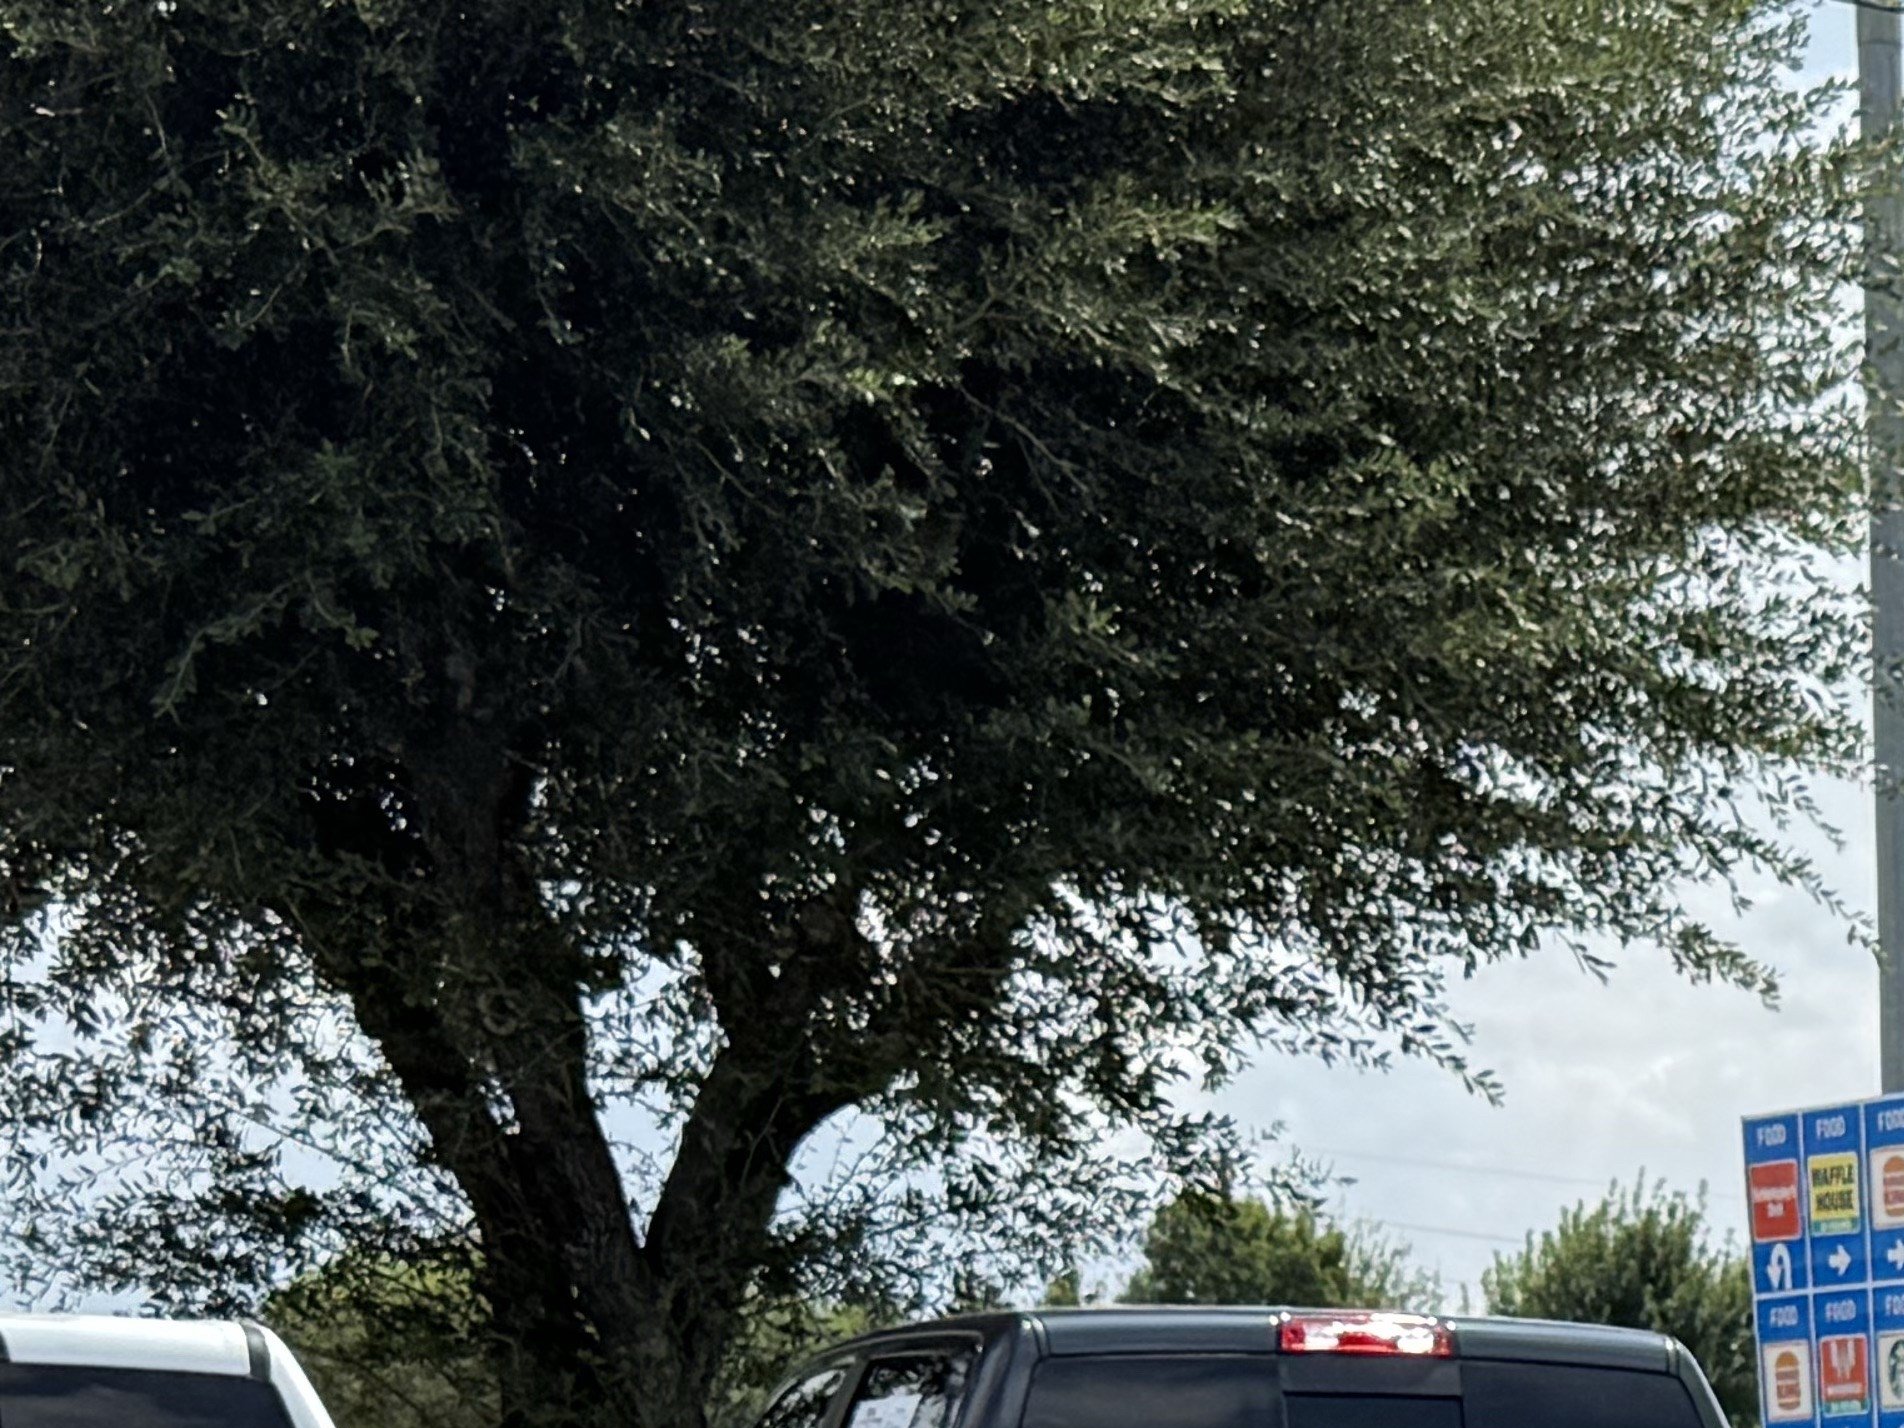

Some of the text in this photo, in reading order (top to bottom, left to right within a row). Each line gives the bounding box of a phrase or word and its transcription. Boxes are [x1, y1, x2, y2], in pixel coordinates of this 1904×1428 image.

[1756, 1123, 1786, 1147] FOOD
[1816, 1115, 1846, 1139] FOOD
[1811, 1163, 1854, 1188] WAFFLE
[1815, 1189, 1854, 1212] HOUSE
[1769, 1305, 1798, 1327] FOOD
[1825, 1300, 1856, 1321] FOOD
